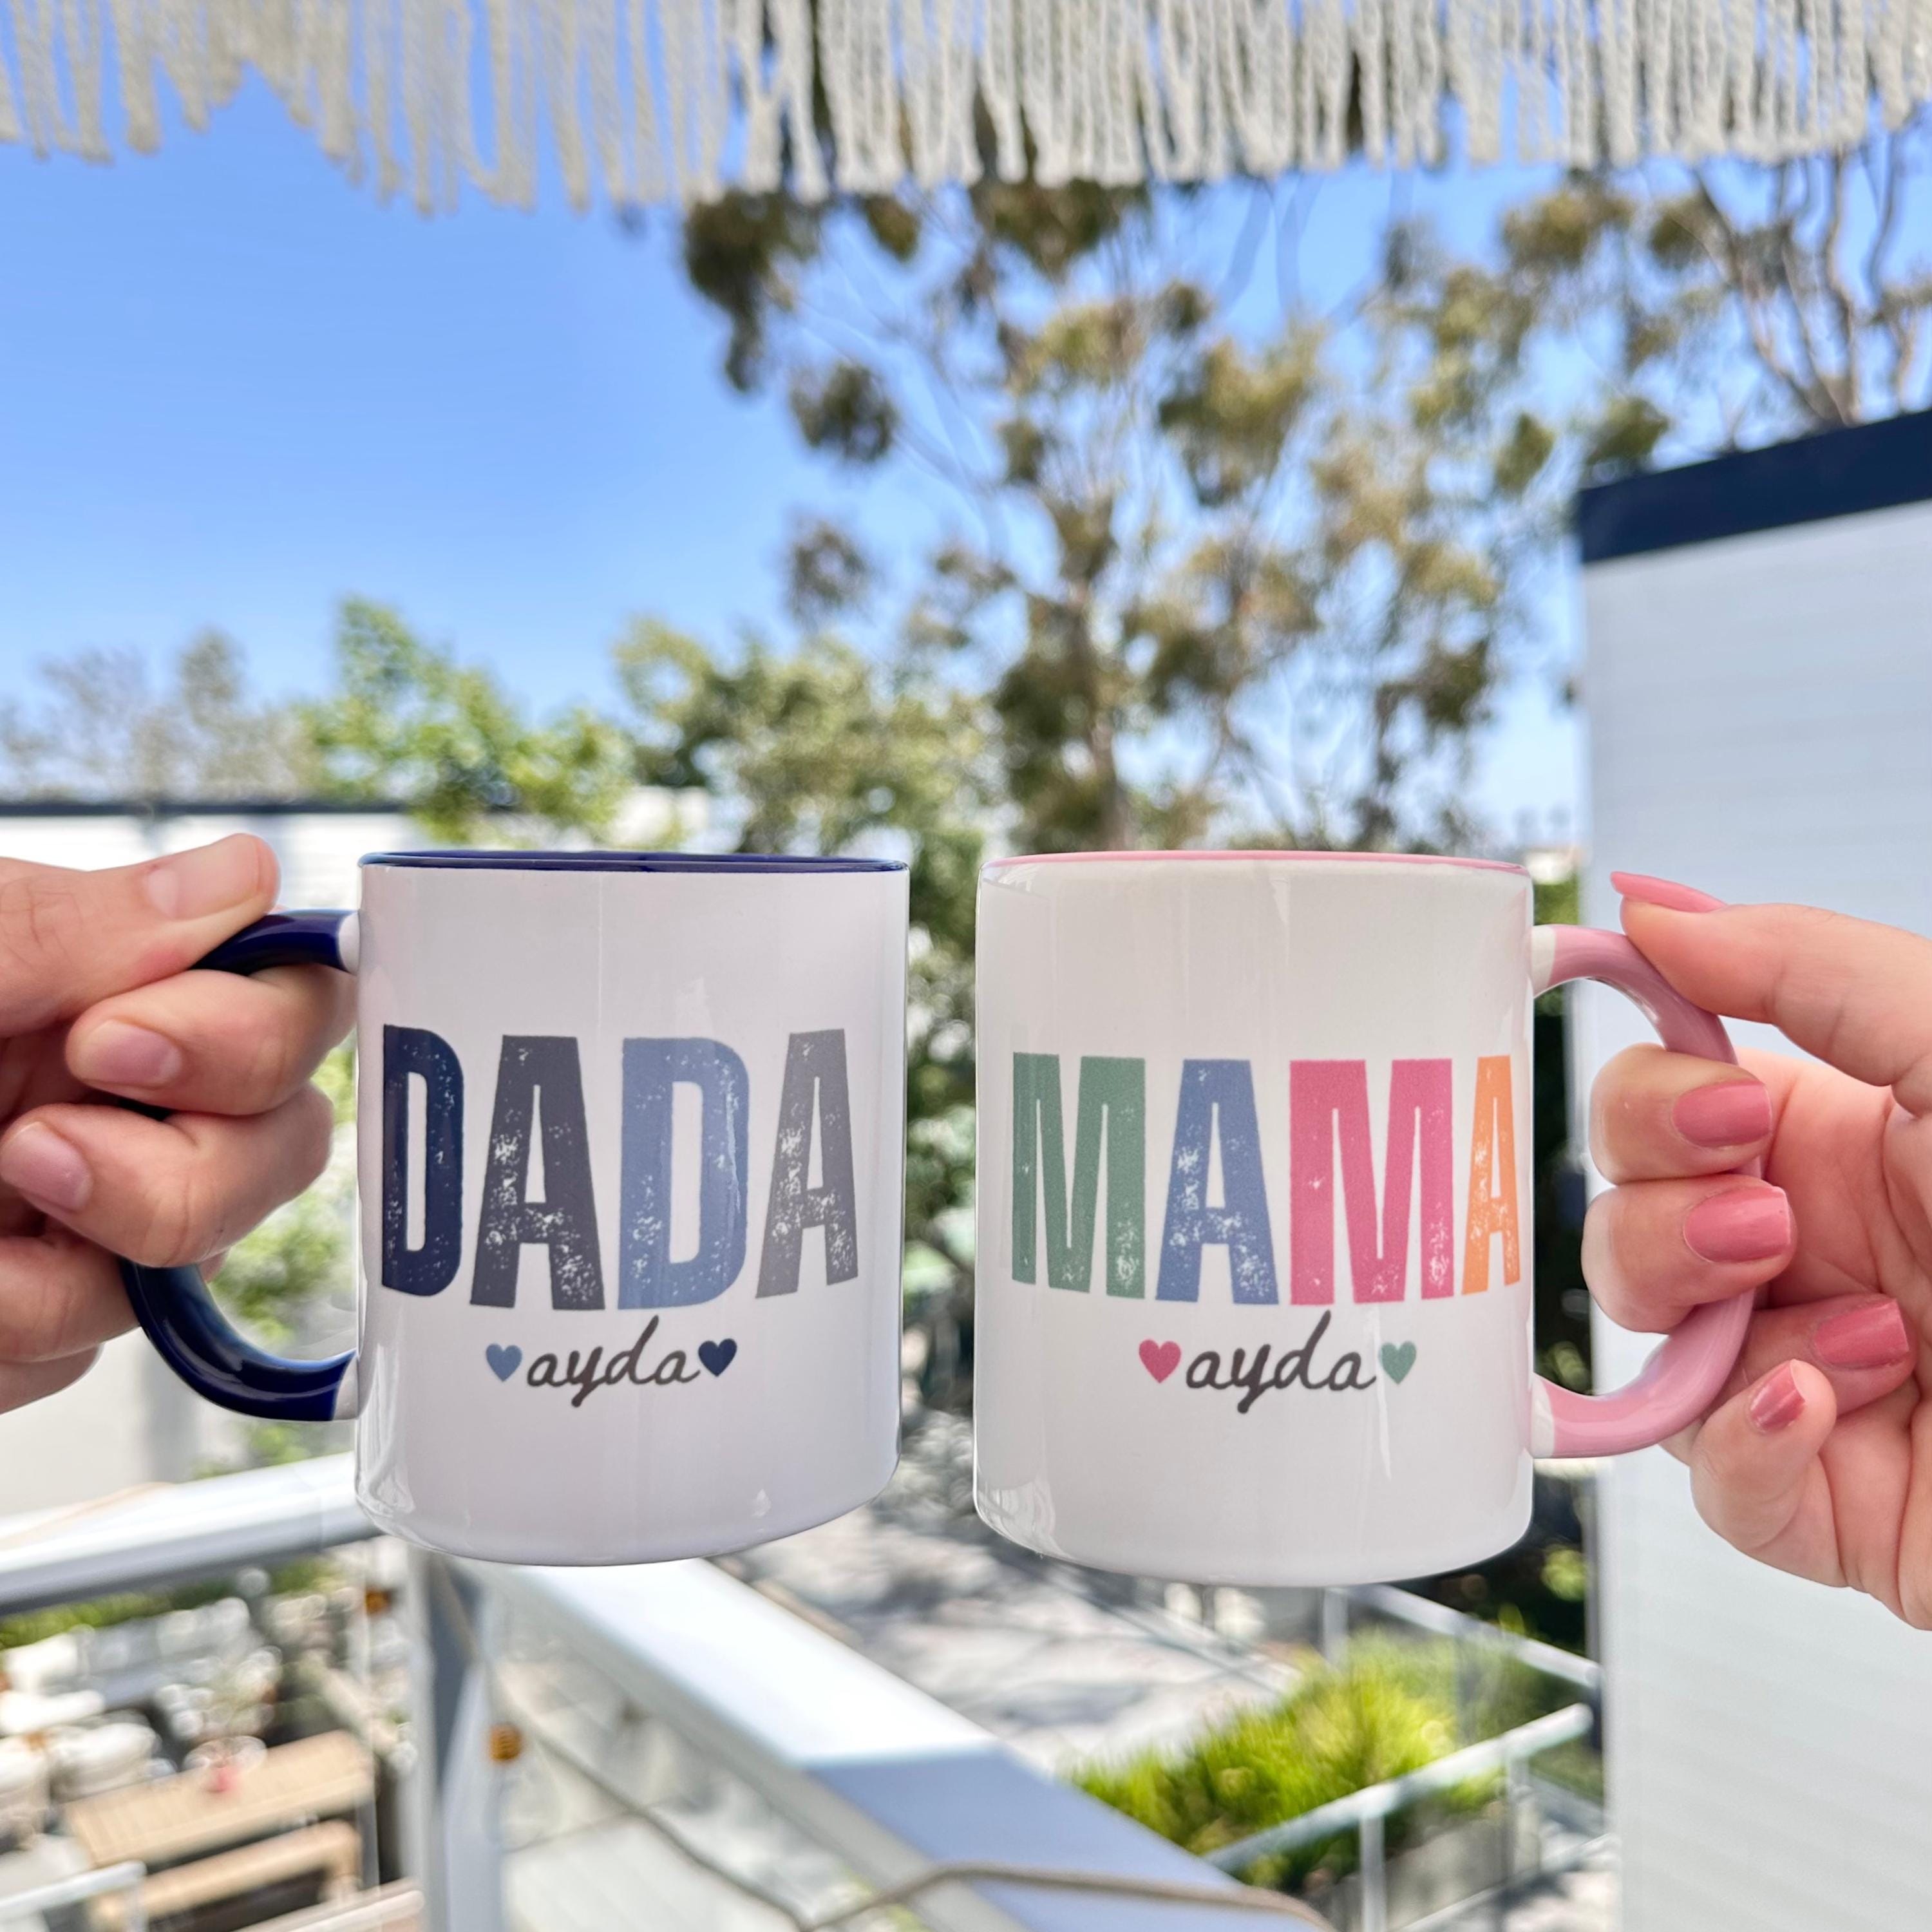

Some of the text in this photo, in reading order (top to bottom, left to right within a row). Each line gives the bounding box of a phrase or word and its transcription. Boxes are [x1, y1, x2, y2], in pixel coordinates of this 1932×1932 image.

[381, 1023, 858, 1311] DADA
[1012, 1052, 1520, 1306] MAMA
[526, 1314, 701, 1408] ayda
[1185, 1310, 1378, 1415] ayda
